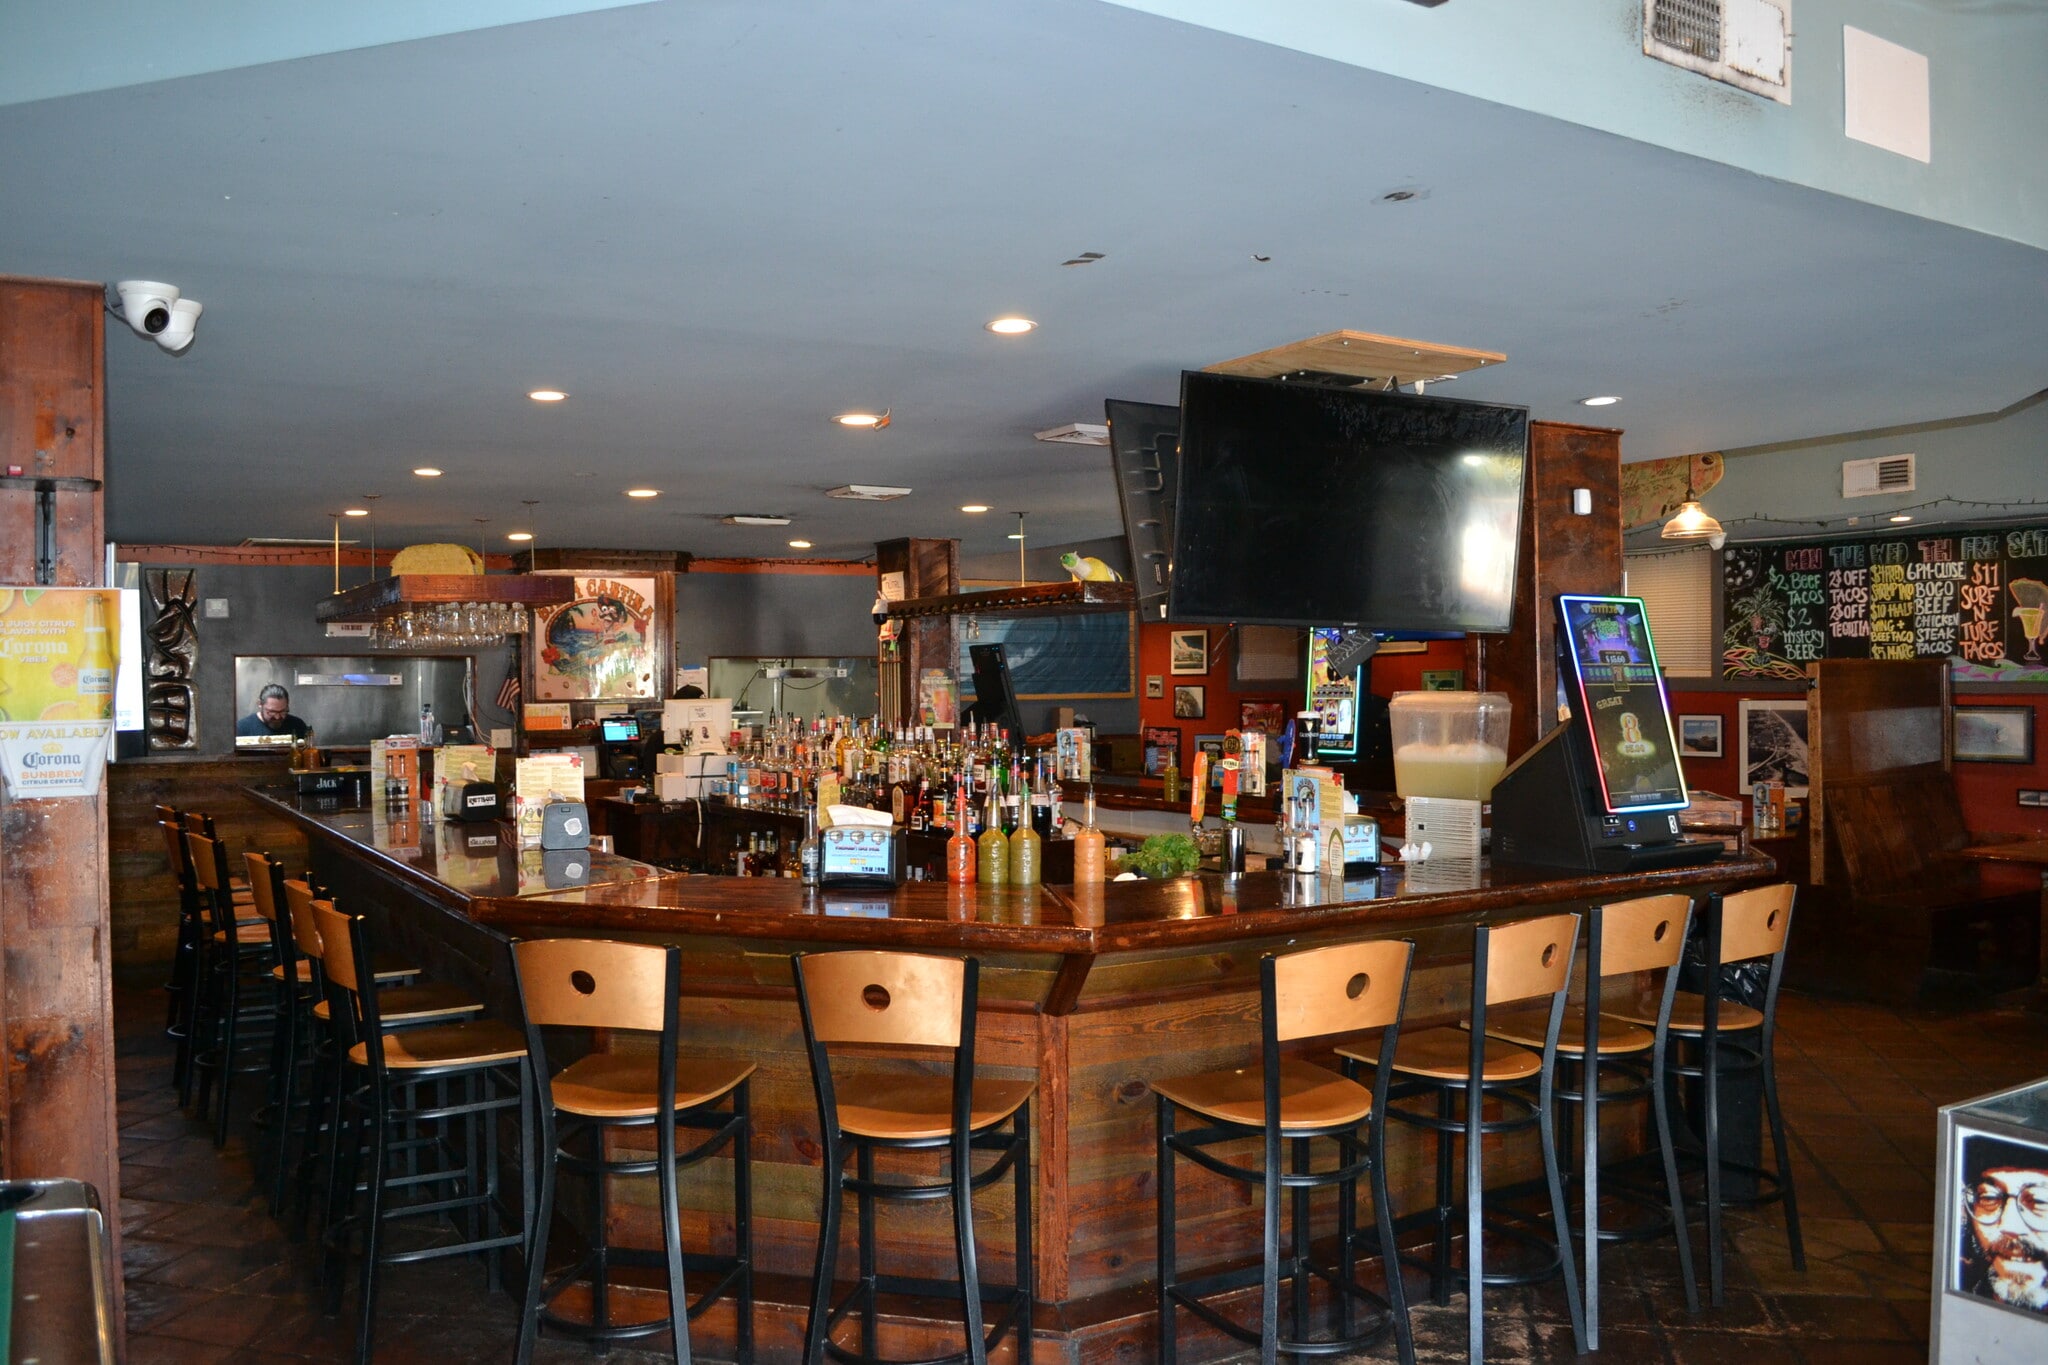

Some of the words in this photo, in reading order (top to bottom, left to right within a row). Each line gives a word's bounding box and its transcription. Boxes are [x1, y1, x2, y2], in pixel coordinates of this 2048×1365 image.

[1918, 539, 1952, 562] TH
[1961, 536, 1999, 560] FRI
[2006, 529, 2048, 558] SAT
[1785, 548, 1822, 571] MON
[1829, 545, 1864, 568] TUE
[1869, 542, 1909, 565] WED
[1843, 569, 1867, 586] OFF
[1971, 562, 1998, 586] $11
[1787, 590, 1825, 606] TACOS
[1829, 587, 1868, 604] TACOS
[1915, 581, 1954, 598] BOGO
[1961, 585, 2000, 610] SURF
[1843, 604, 1866, 619] OFF
[1888, 602, 1913, 617] HALF
[1914, 596, 1954, 615] BEEF
[8, 620, 36, 628] JUICY
[40, 620, 76, 628] CITRUS
[1829, 620, 1870, 637] TEQUILA
[1871, 620, 1895, 632] WING
[1915, 613, 1960, 628] CHICKEN
[0, 627, 37, 635] FLAVOR
[40, 627, 66, 635] WITH
[1871, 631, 1892, 643] BEEF
[1892, 631, 1914, 643] TACO
[1916, 627, 1956, 643] STEAK
[1961, 620, 1999, 641] TURF
[0, 637, 69, 659] Corona
[1784, 644, 1823, 660] BEER
[1887, 644, 1914, 659] MARG
[1915, 640, 1953, 655] TACOS
[1960, 641, 2004, 660] TACOS
[0, 729, 20, 739] OW
[22, 751, 81, 769] Corona
[21, 770, 84, 779] SUNBREW
